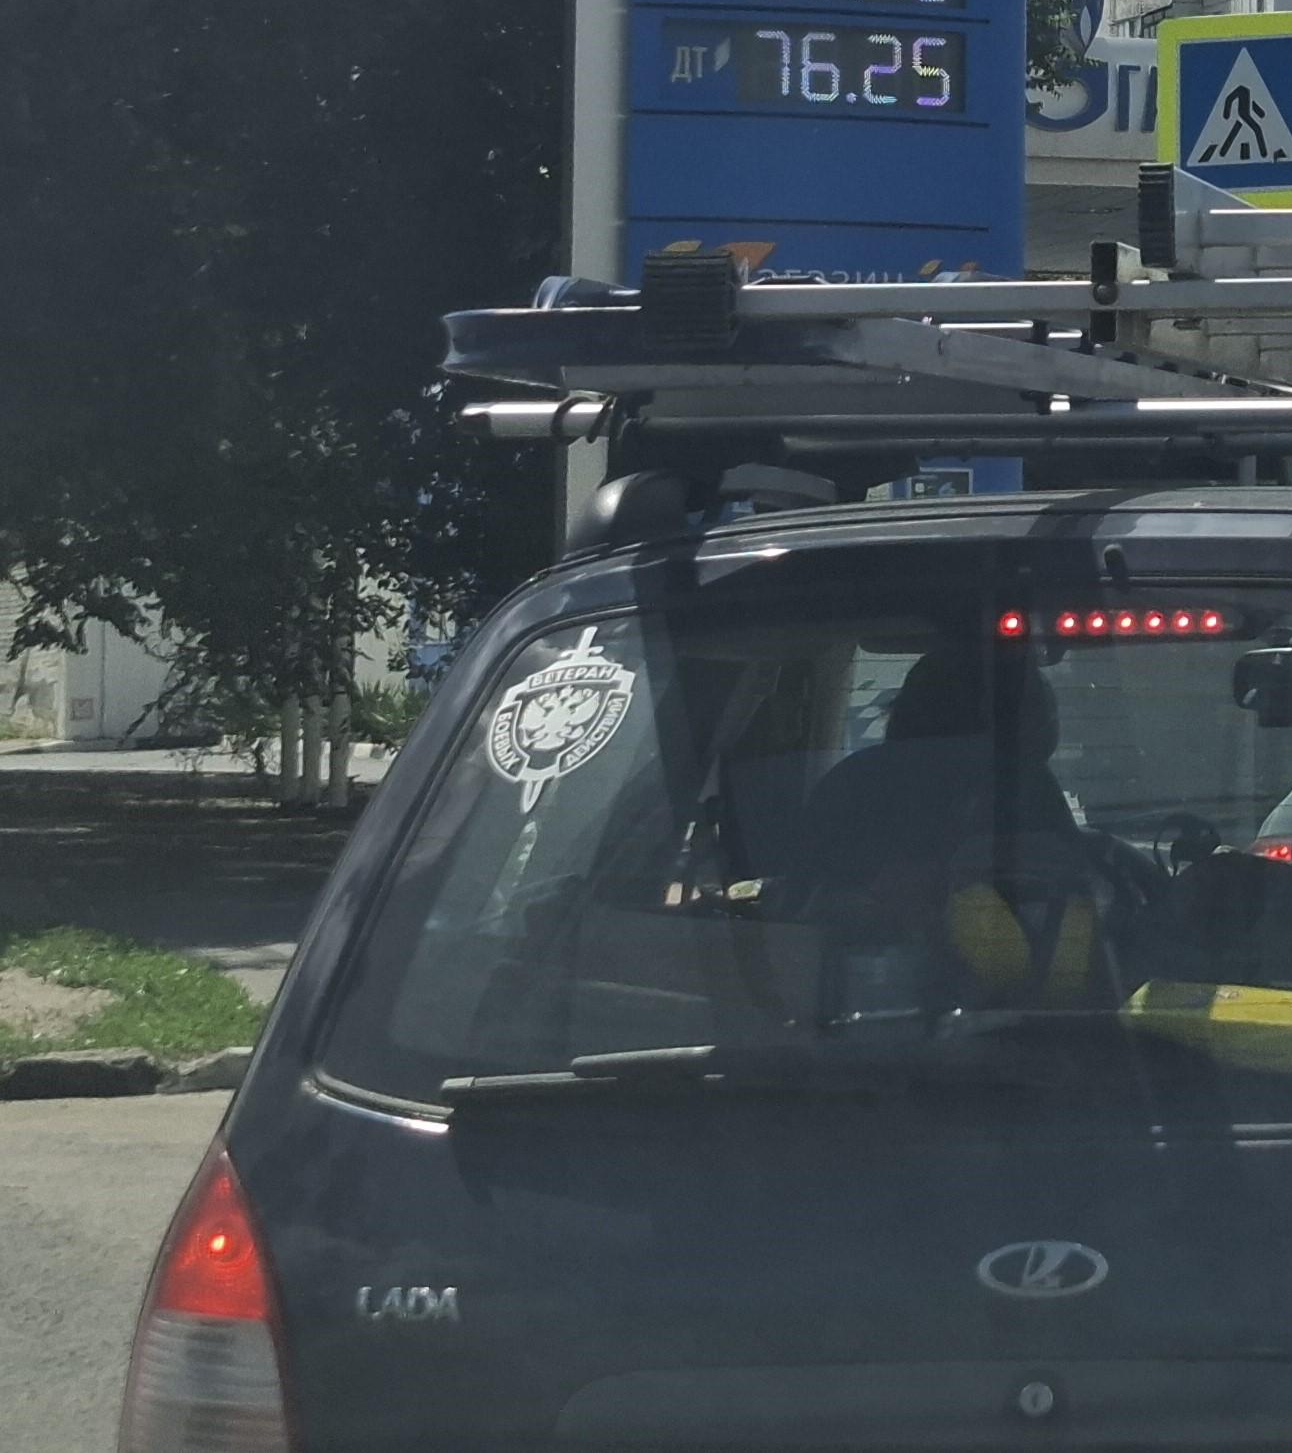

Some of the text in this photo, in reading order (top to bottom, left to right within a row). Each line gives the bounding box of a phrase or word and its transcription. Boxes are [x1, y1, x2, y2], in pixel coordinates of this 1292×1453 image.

[671, 30, 951, 106] ДТ 76.25
[531, 664, 616, 687] ВЕТЕРАН
[493, 711, 521, 771] БОЕВЫХ
[356, 1285, 461, 1323] LADA
